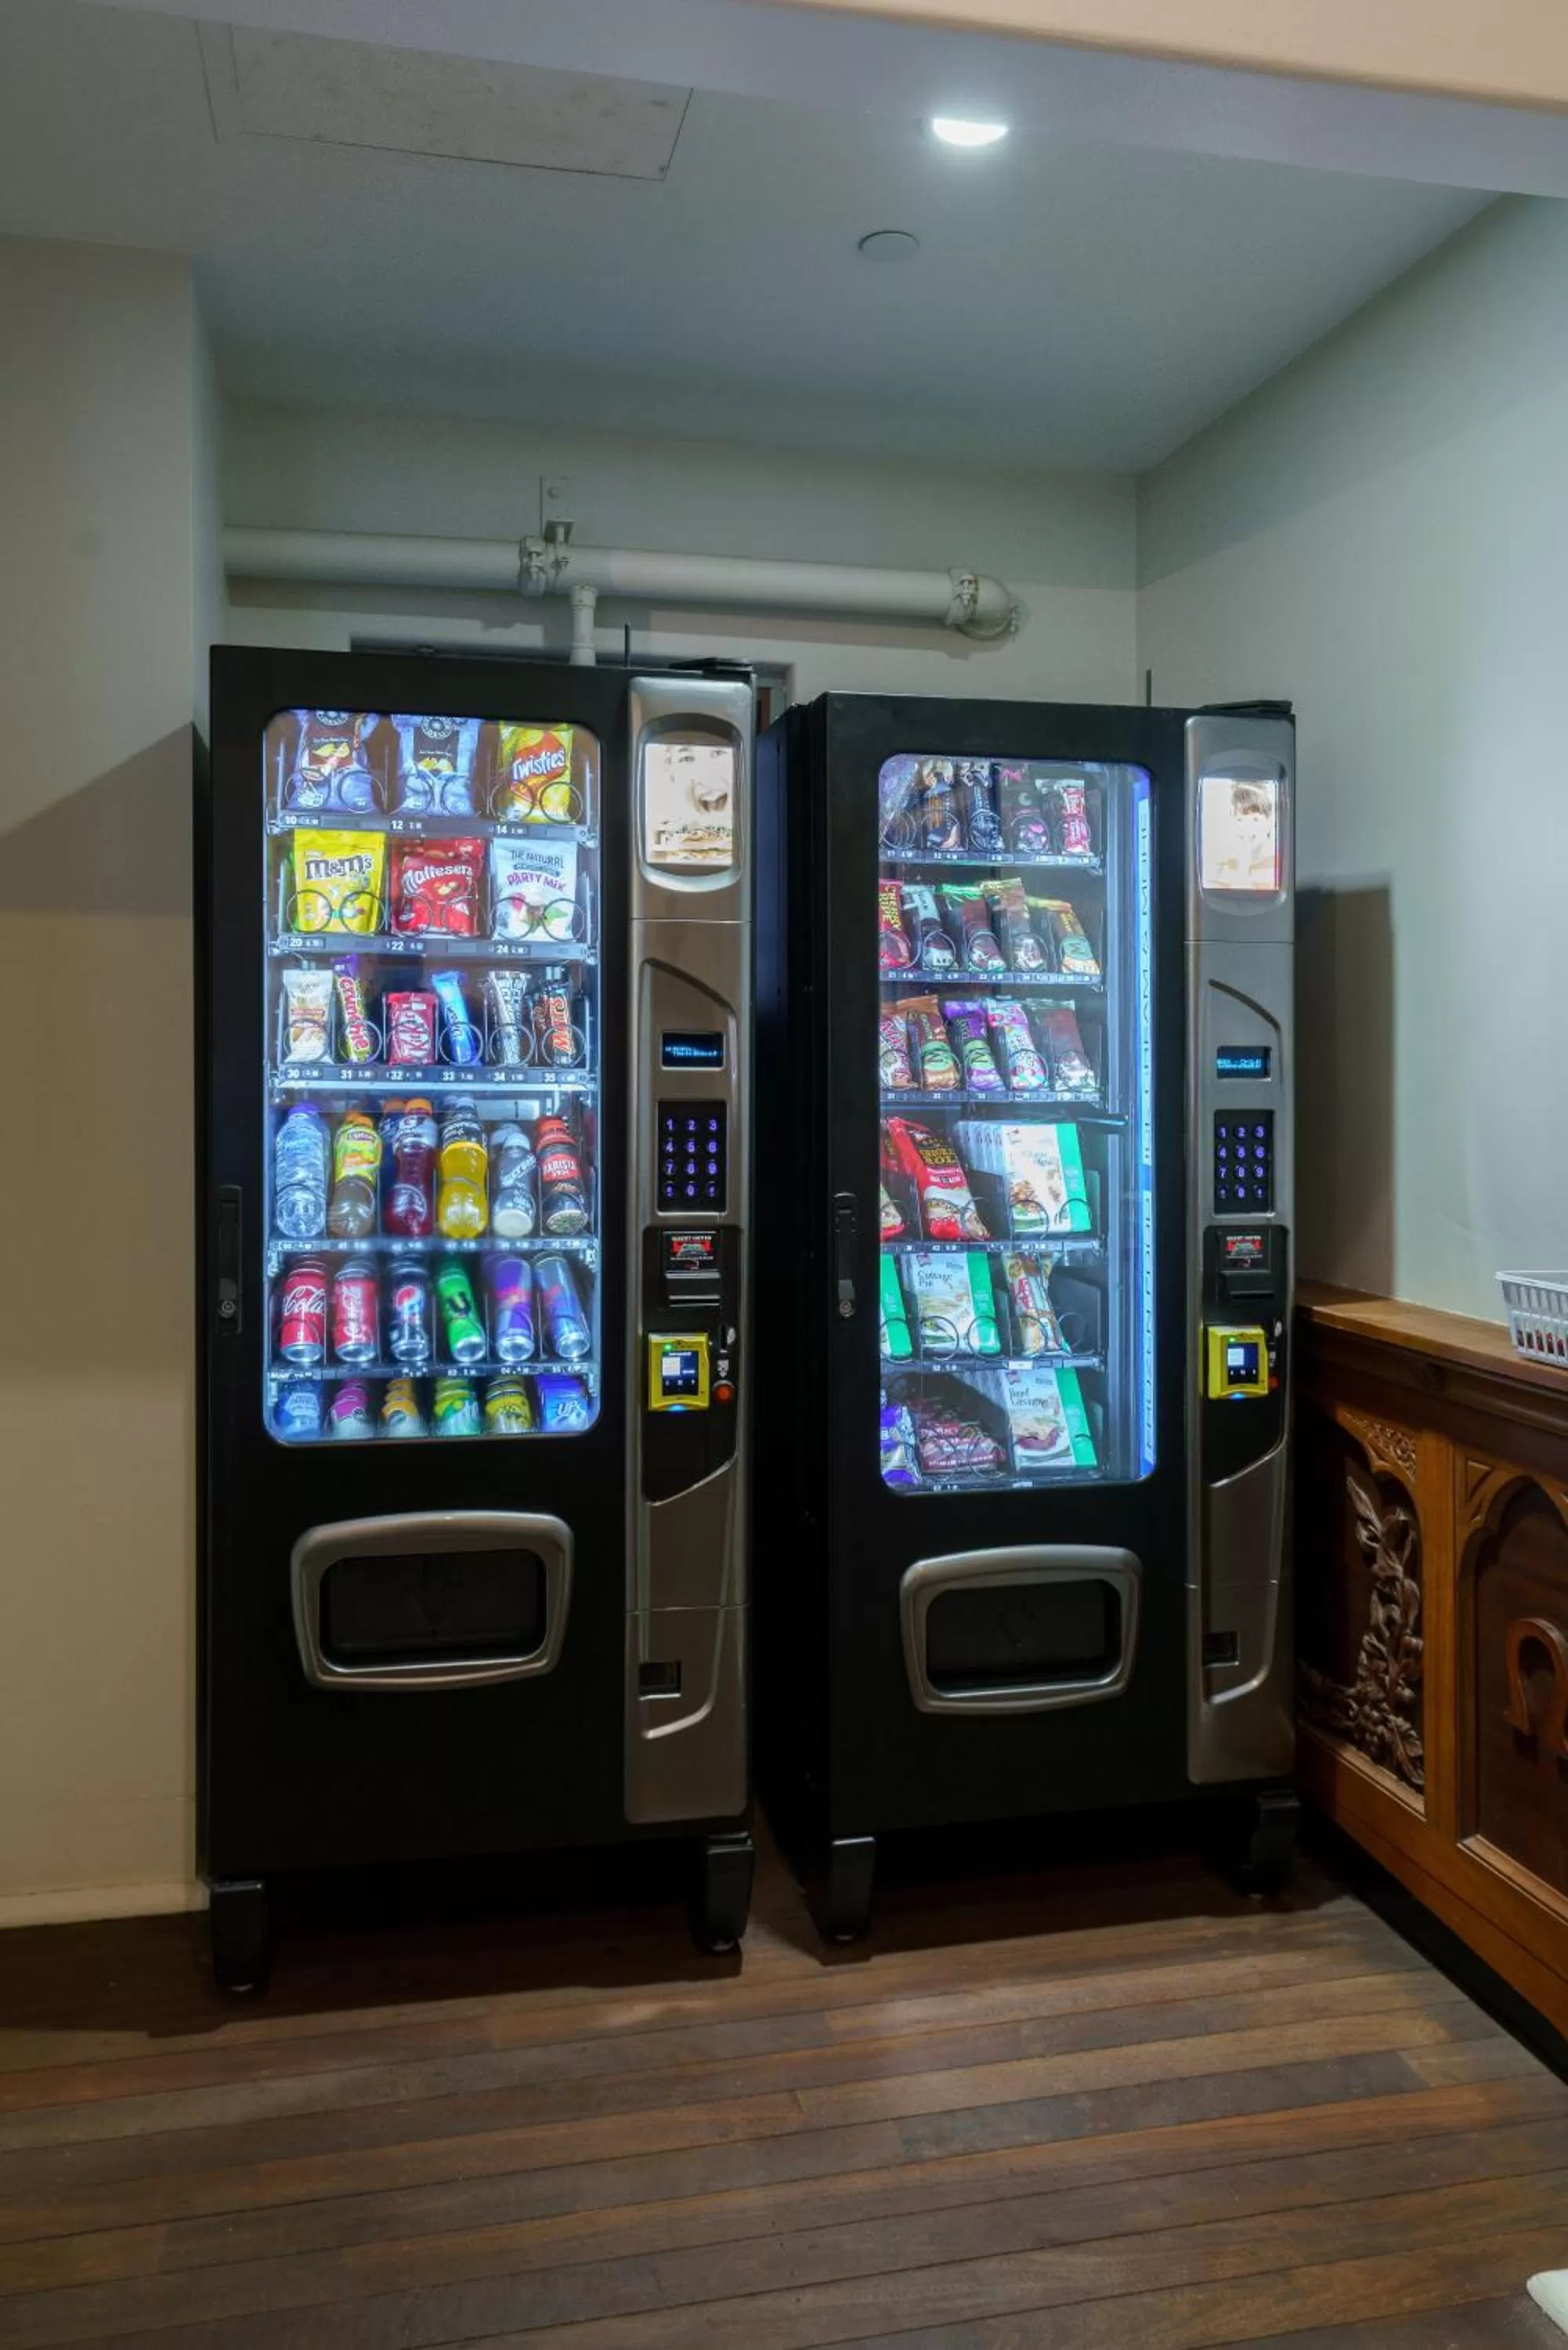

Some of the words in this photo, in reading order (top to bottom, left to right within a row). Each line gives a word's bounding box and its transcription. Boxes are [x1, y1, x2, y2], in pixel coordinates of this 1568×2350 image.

[512, 750, 565, 780] Twisties
[497, 825, 508, 834] 14
[402, 864, 473, 895] Maltesers
[507, 872, 543, 886] PARTY
[688, 1119, 695, 1131] 2
[666, 1141, 674, 1153] 4
[666, 1162, 674, 1174] 7
